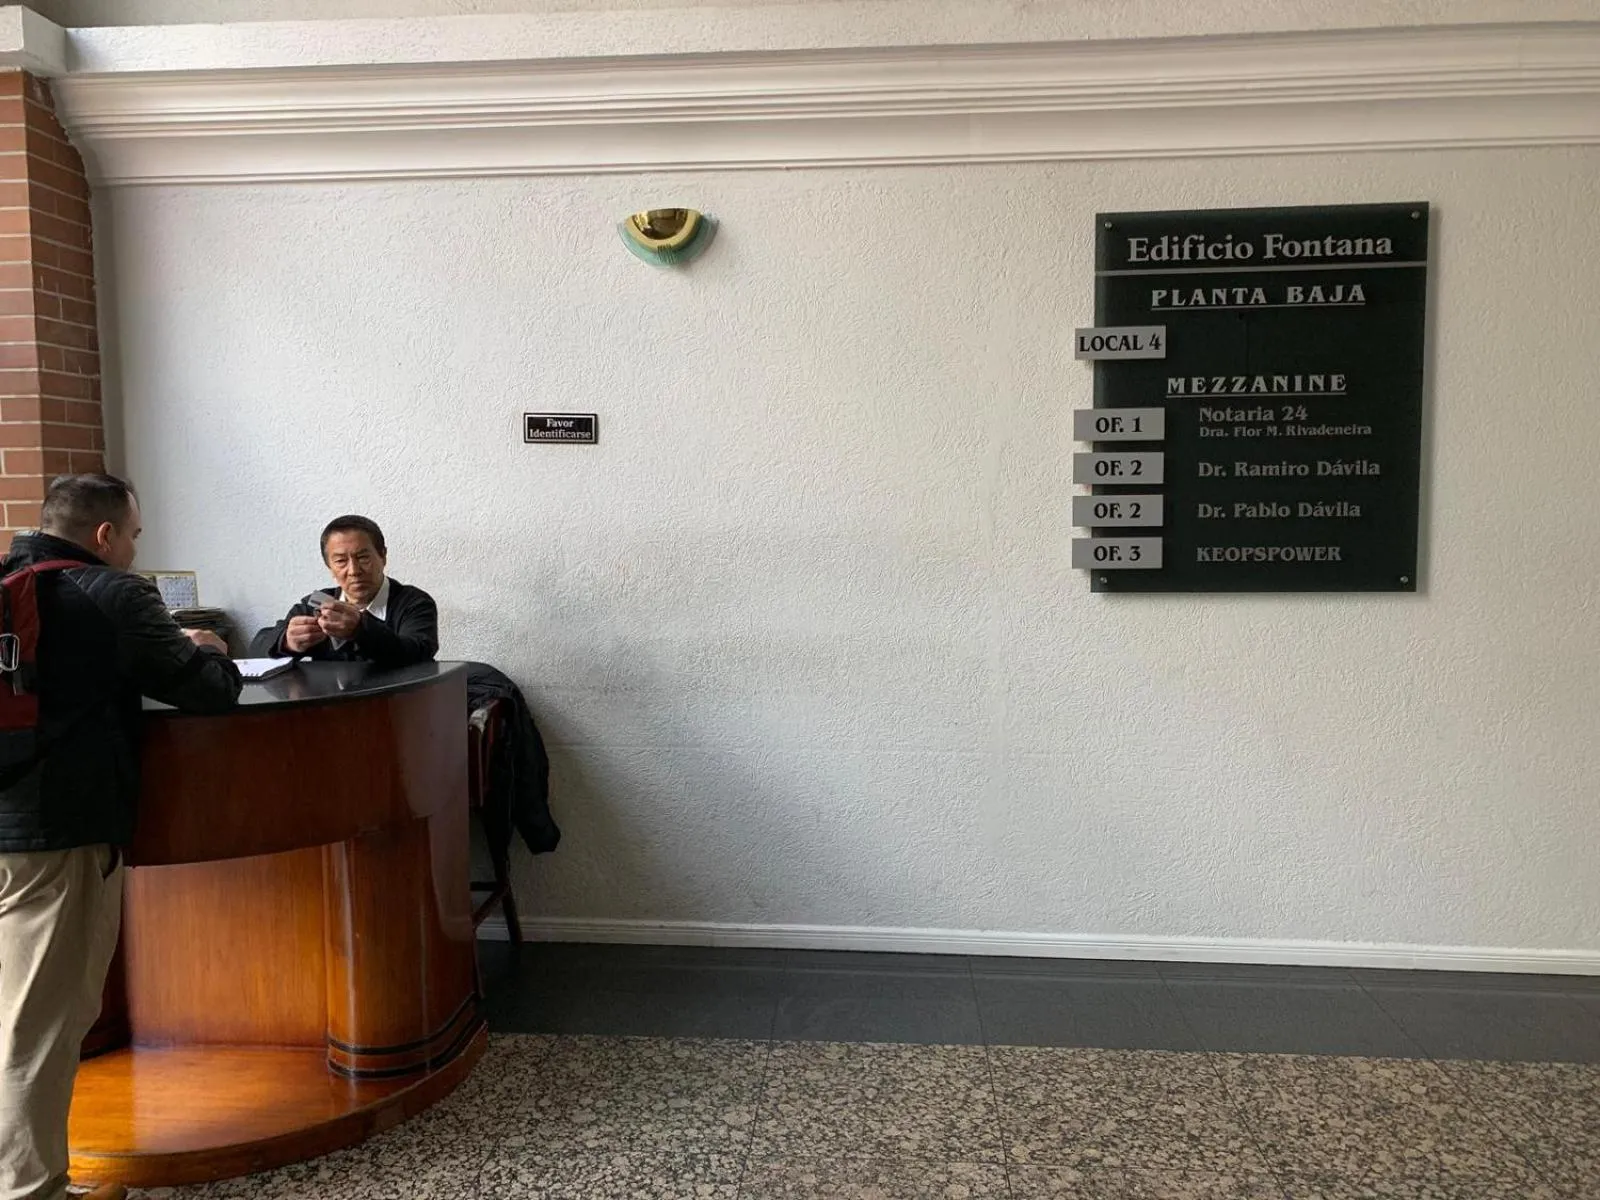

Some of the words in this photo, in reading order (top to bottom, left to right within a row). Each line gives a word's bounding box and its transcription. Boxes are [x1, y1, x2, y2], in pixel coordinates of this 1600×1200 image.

[1127, 234, 1254, 262] Edificio
[1263, 233, 1393, 260] Fontana
[1151, 287, 1268, 307] PLANTA
[1286, 284, 1366, 304] BAJA
[1079, 334, 1144, 352] LOCAL
[1149, 332, 1162, 350] 4
[1166, 374, 1347, 394] MEZZANINE
[1199, 405, 1275, 423] Notaria
[1281, 405, 1308, 421] 24
[546, 418, 574, 428] Favor
[1095, 417, 1124, 433] OF.
[1132, 417, 1143, 433] 1
[1199, 426, 1230, 437] Dra.
[1233, 425, 1262, 437] Flor
[1266, 425, 1283, 436] M.
[1285, 424, 1373, 436] Rivadeneira
[529, 428, 591, 439] Identificarse
[1094, 460, 1124, 477] OF.
[1130, 460, 1143, 476] 2
[1198, 462, 1227, 478] Dr.
[1234, 461, 1310, 477] Ramiro
[1316, 460, 1381, 476] Dávila
[1093, 503, 1123, 519] OF.
[1129, 502, 1142, 518] 2
[1197, 503, 1226, 519] Dr.
[1233, 502, 1291, 518] Pablo
[1297, 501, 1362, 518] Dávila
[1093, 546, 1122, 562] OF.
[1129, 545, 1141, 561] 3
[1196, 546, 1342, 562] KEOPSPOWER
